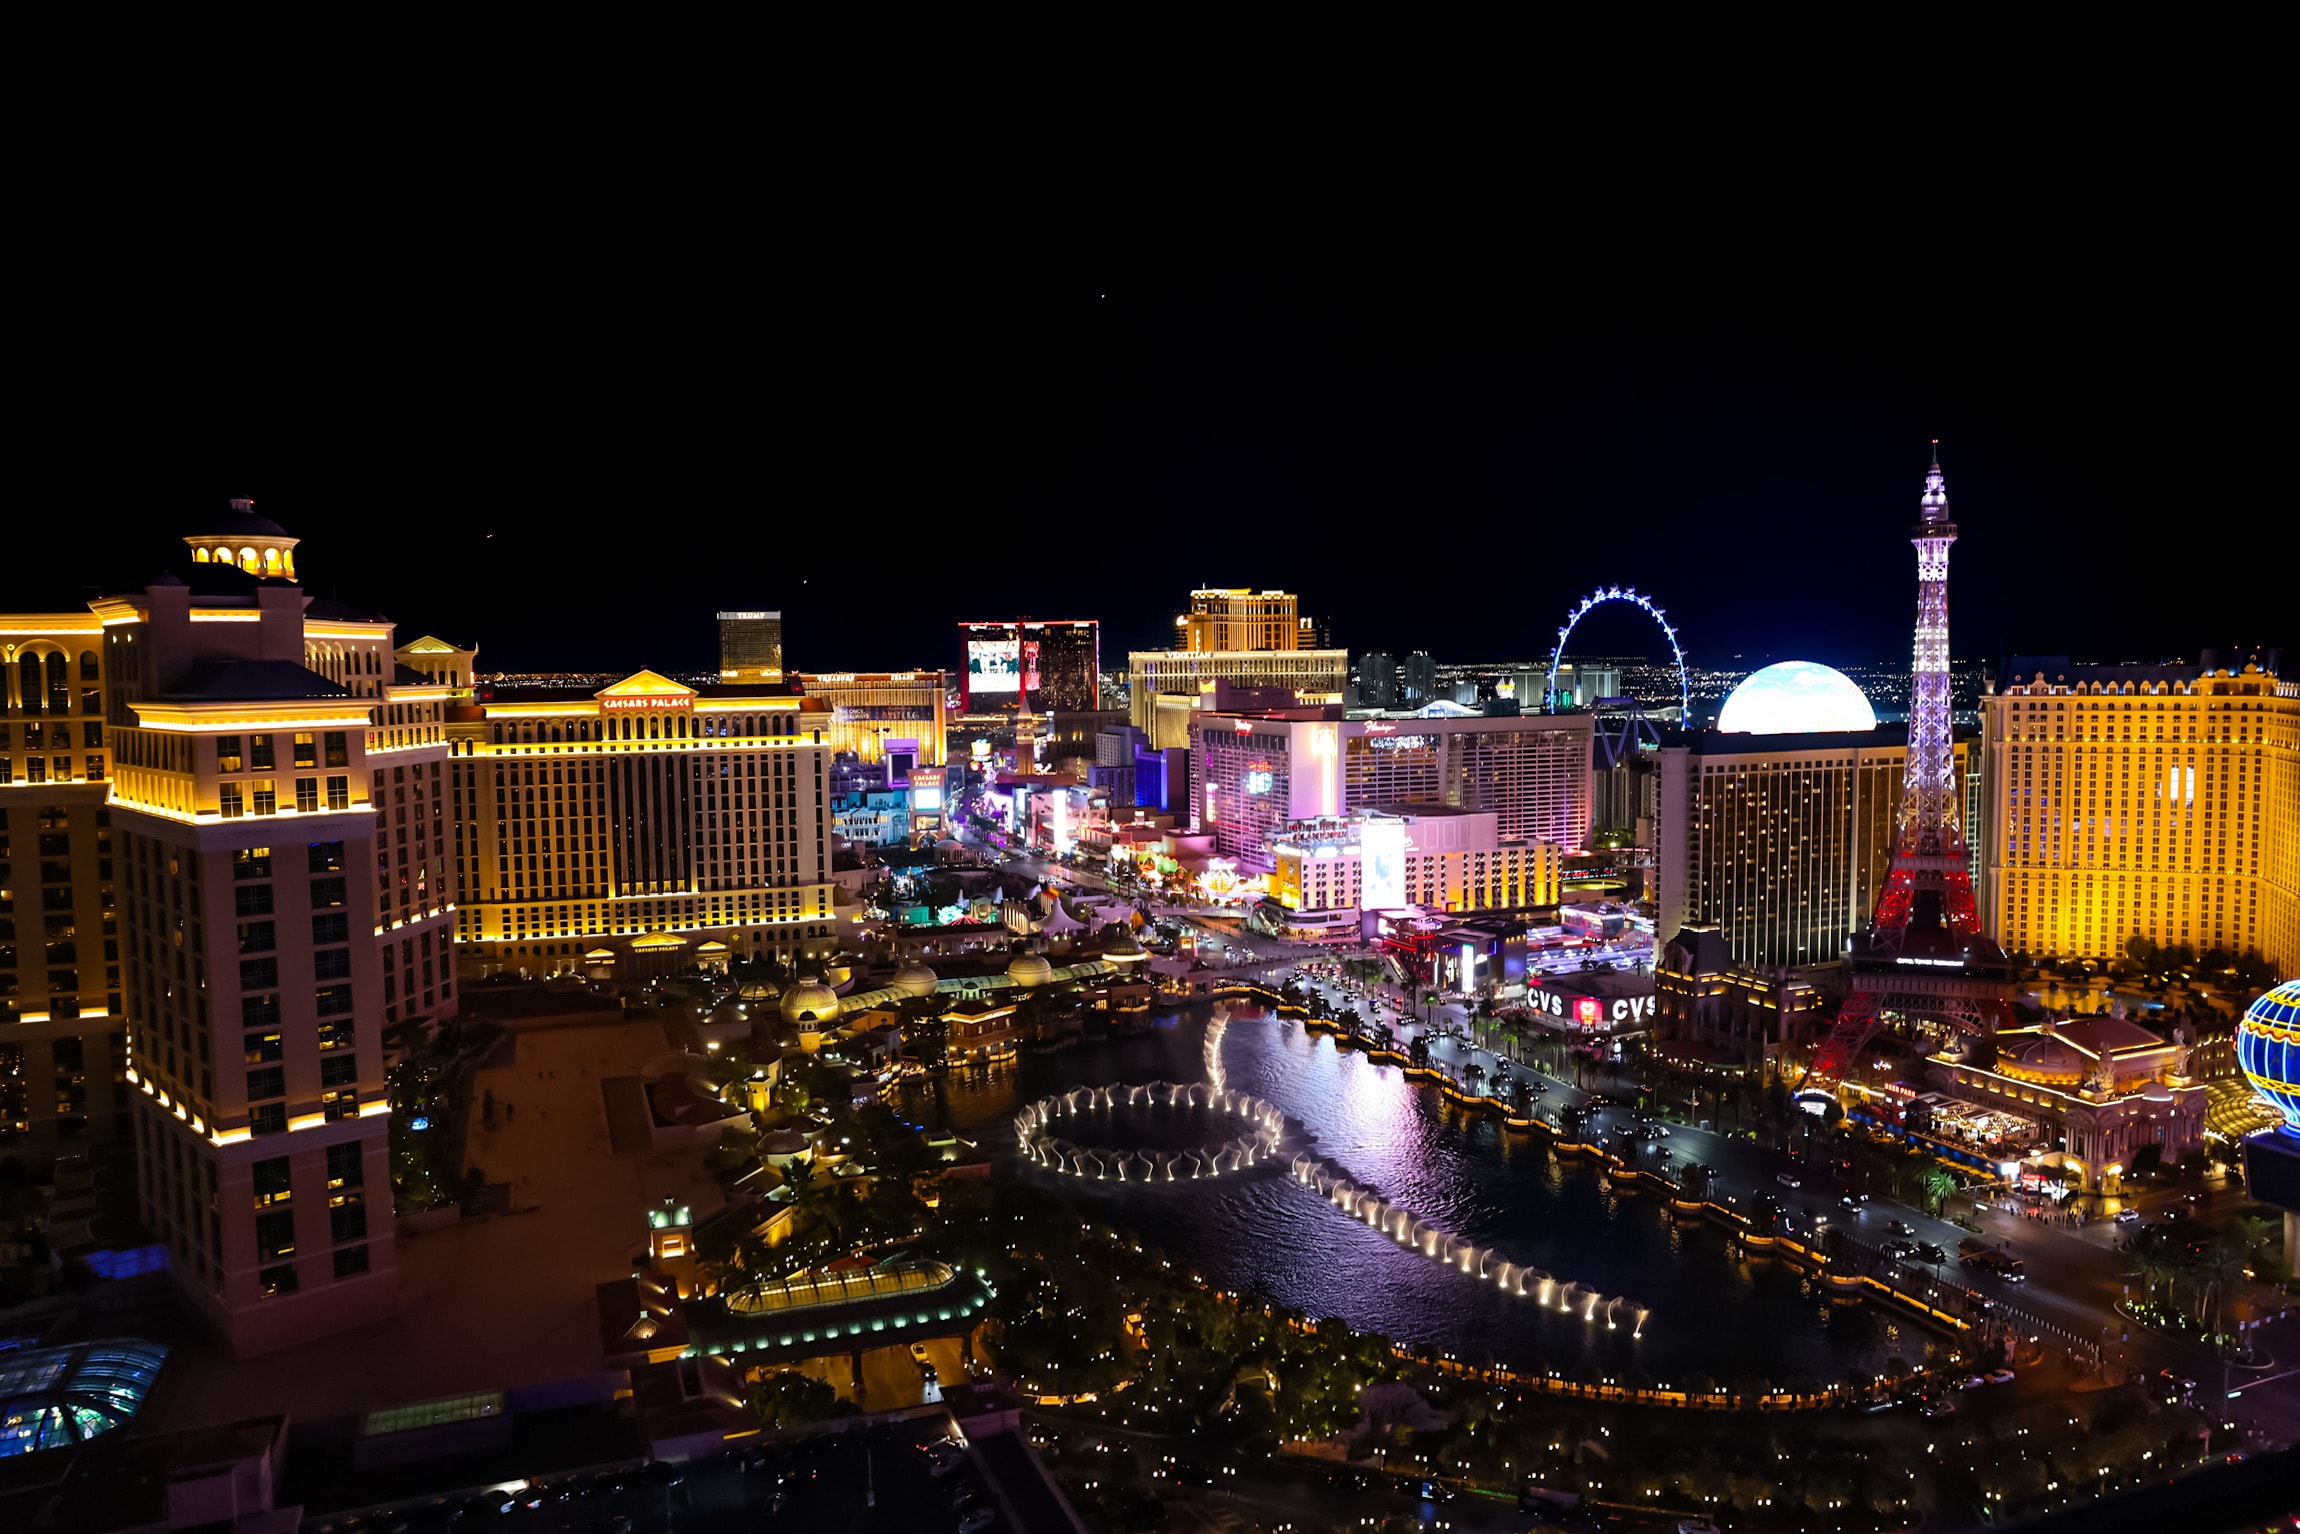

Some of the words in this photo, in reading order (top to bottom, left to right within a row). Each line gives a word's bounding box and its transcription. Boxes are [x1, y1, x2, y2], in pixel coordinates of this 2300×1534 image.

[603, 699, 648, 709] CAESARS
[651, 698, 690, 708] PALACE
[1527, 987, 1563, 1016] CVS
[1612, 995, 1656, 1020] CVS
[1884, 1082, 1900, 1093] BEER
[1900, 1087, 1917, 1098] PARK
